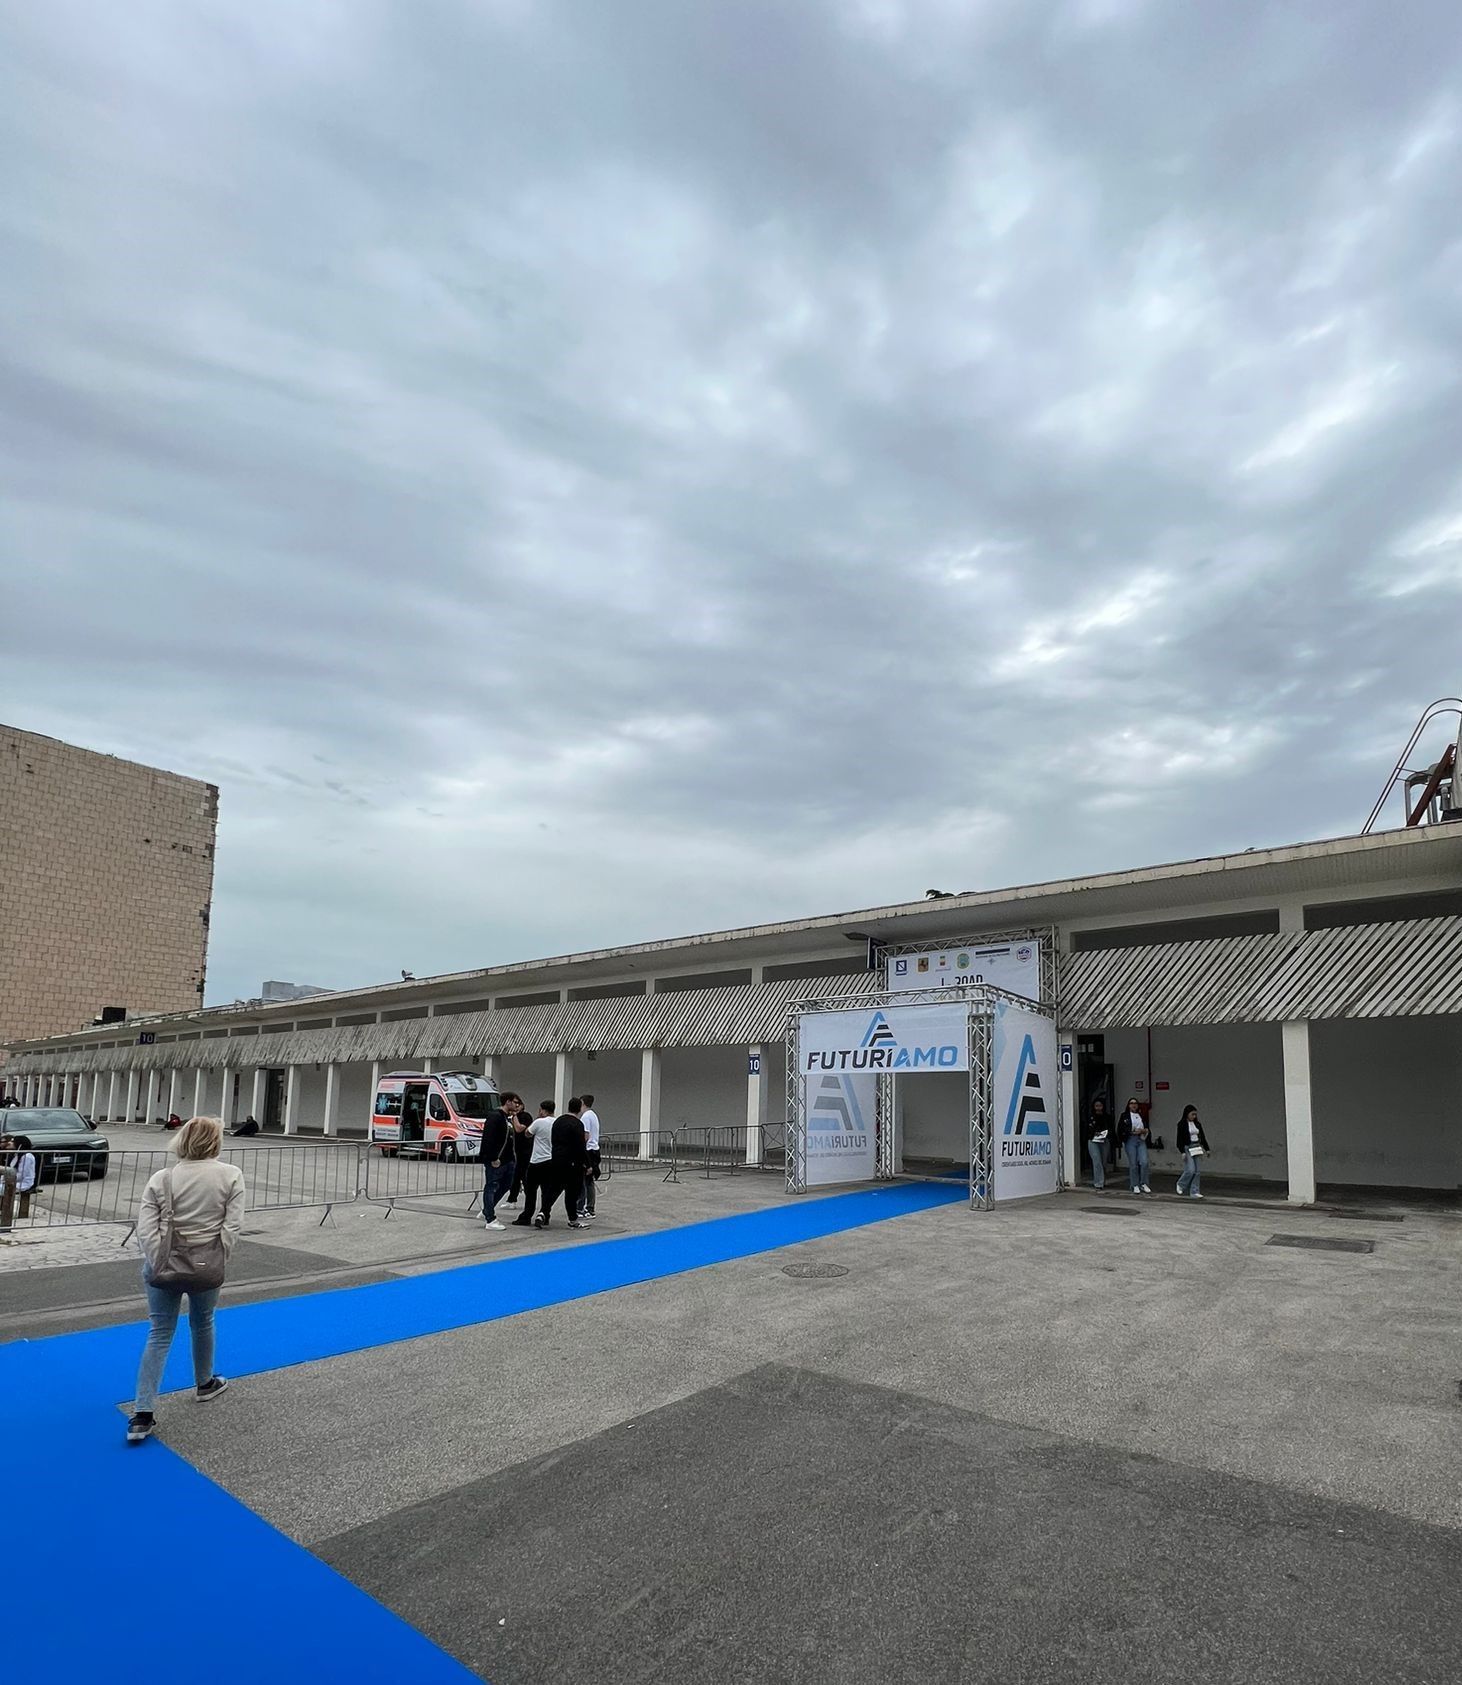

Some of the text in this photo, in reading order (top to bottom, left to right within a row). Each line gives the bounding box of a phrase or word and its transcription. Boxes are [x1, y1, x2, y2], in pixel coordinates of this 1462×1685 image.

[142, 1033, 154, 1043] 10
[749, 1059, 760, 1071] 10
[1001, 1141, 1052, 1157] FUTURIAMO
